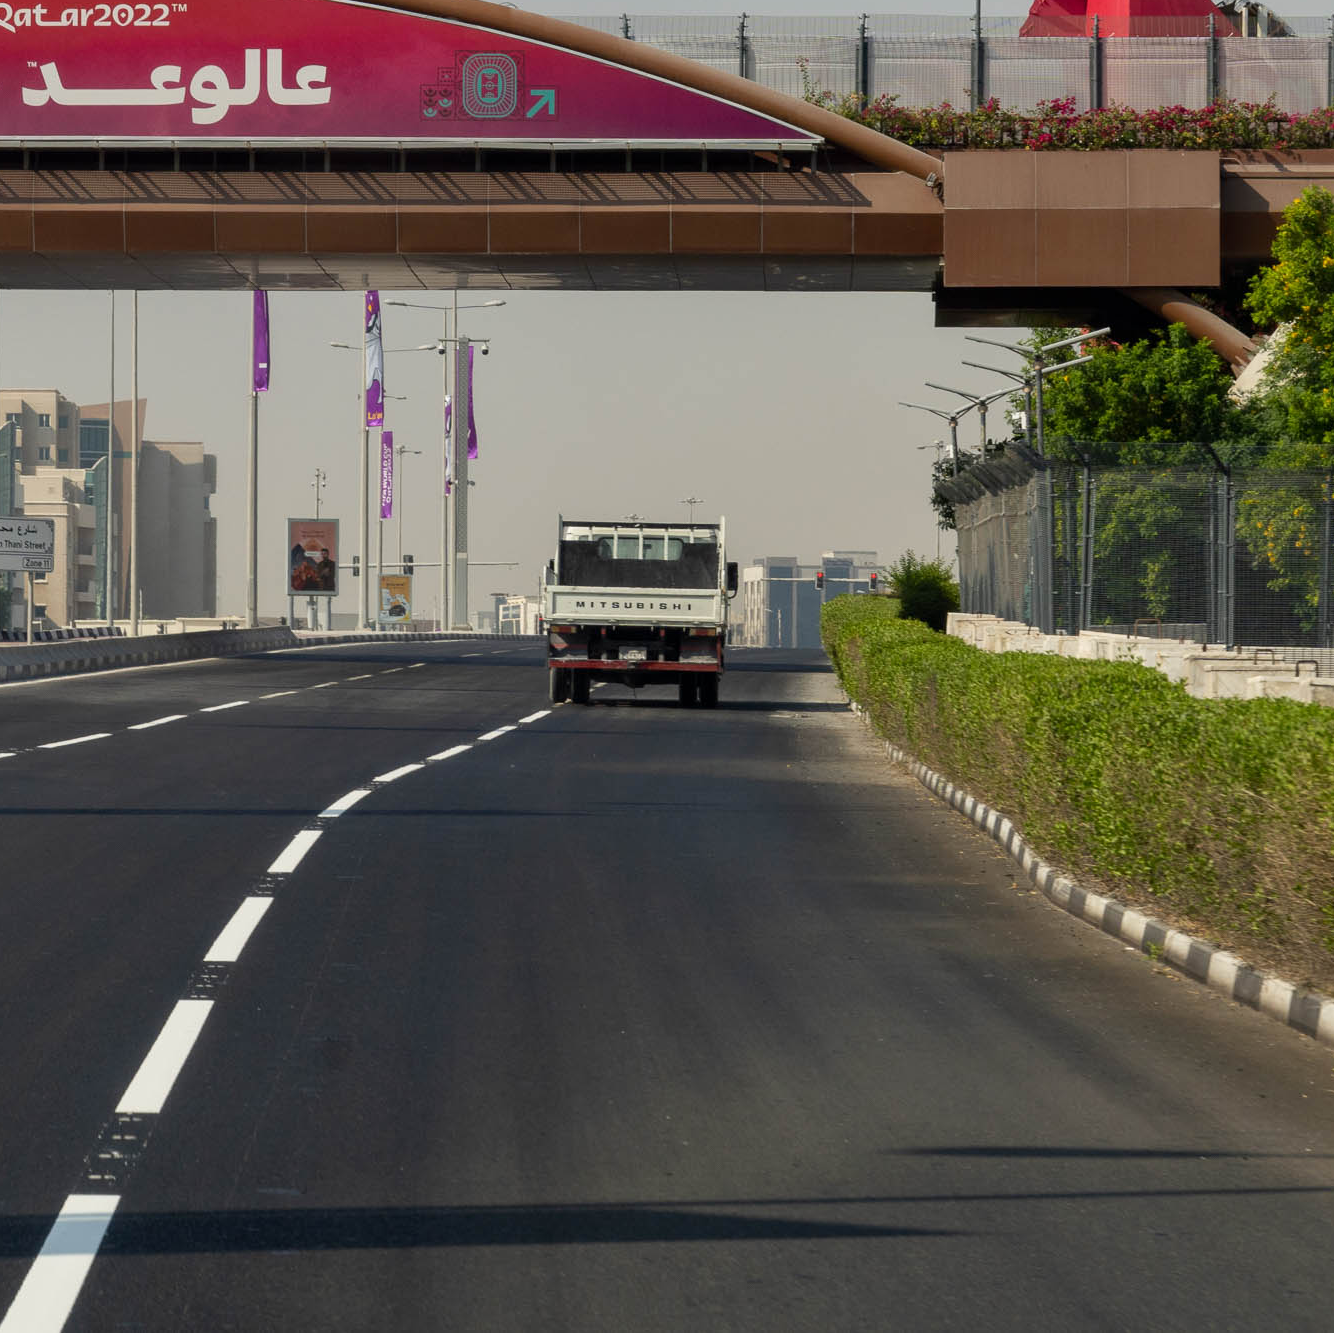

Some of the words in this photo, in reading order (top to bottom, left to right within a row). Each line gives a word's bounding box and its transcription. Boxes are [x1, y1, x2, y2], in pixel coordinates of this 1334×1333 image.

[17, 524, 37, 536] شارع
[5, 540, 22, 549] Thani
[24, 540, 46, 549] Street
[576, 601, 691, 610] MITSUBISHI
